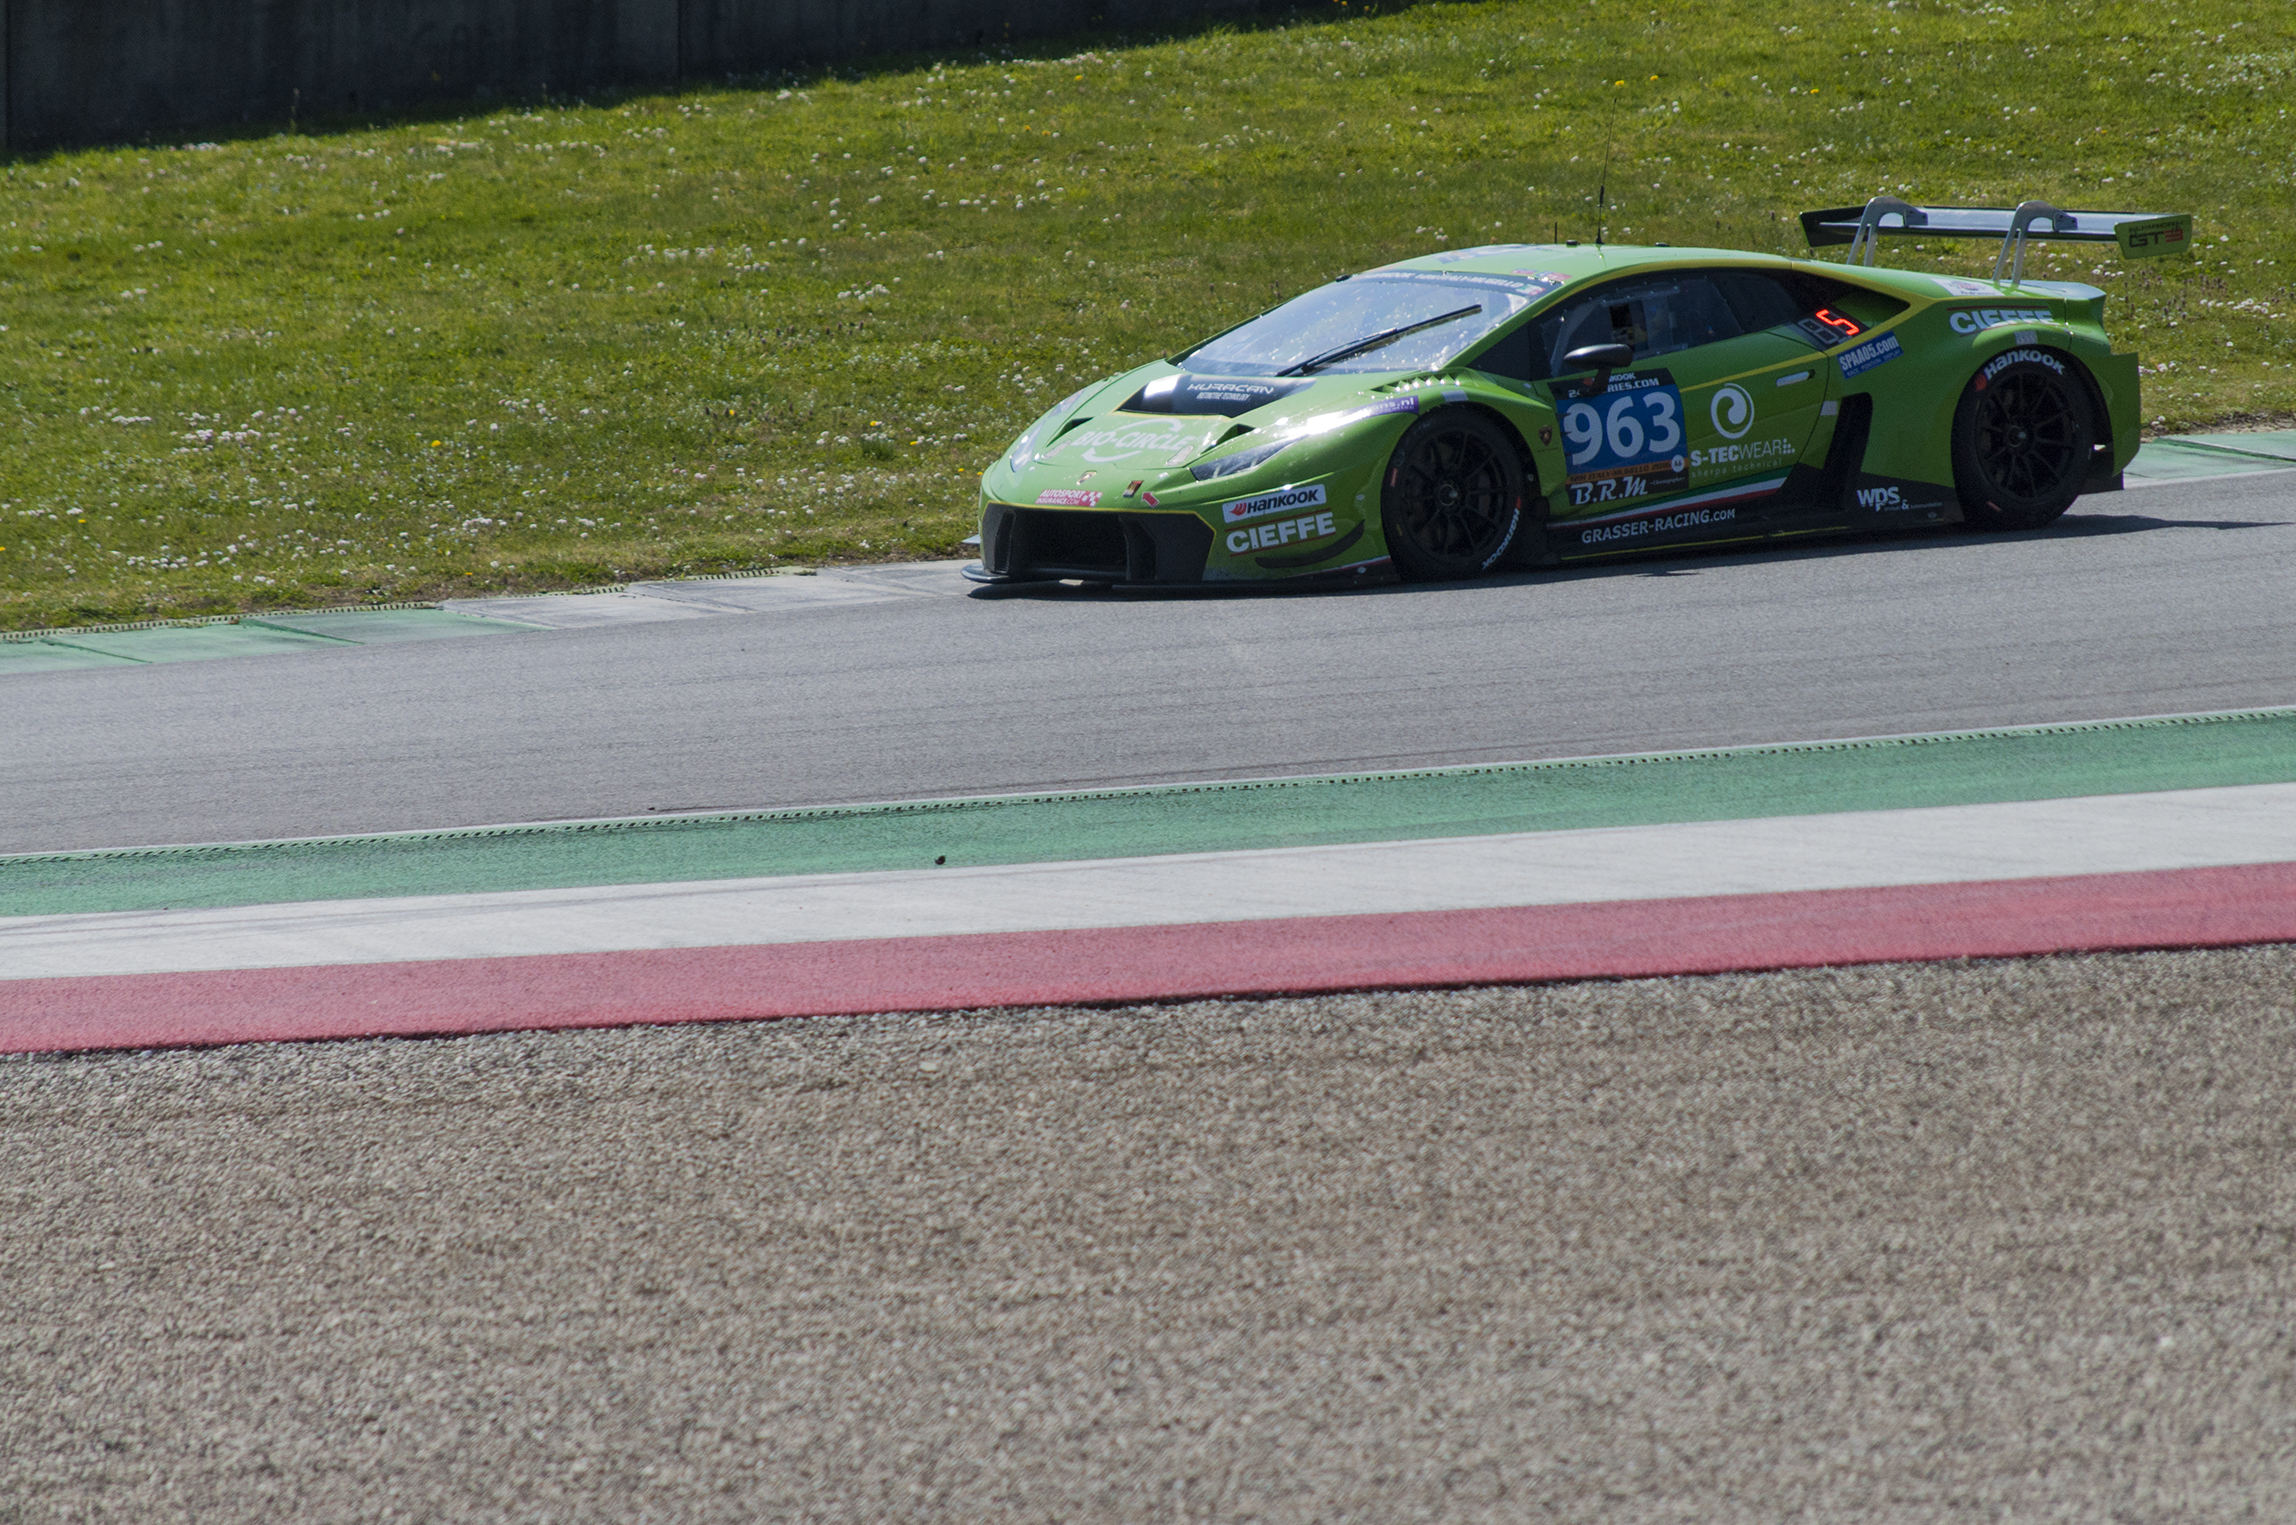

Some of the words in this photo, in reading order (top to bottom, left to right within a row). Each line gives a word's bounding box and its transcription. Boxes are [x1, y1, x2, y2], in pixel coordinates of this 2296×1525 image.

[2129, 228, 2184, 248] GT3
[1949, 309, 2060, 334] CIEFFE
[1070, 430, 1195, 450] BIO-CIRCLE
[1563, 391, 1681, 466] 963
[1040, 489, 1085, 499] AUTOSPORT
[1226, 511, 1337, 553] CIEFFE
[1581, 508, 1736, 544] GRASSER-RACING.COM
